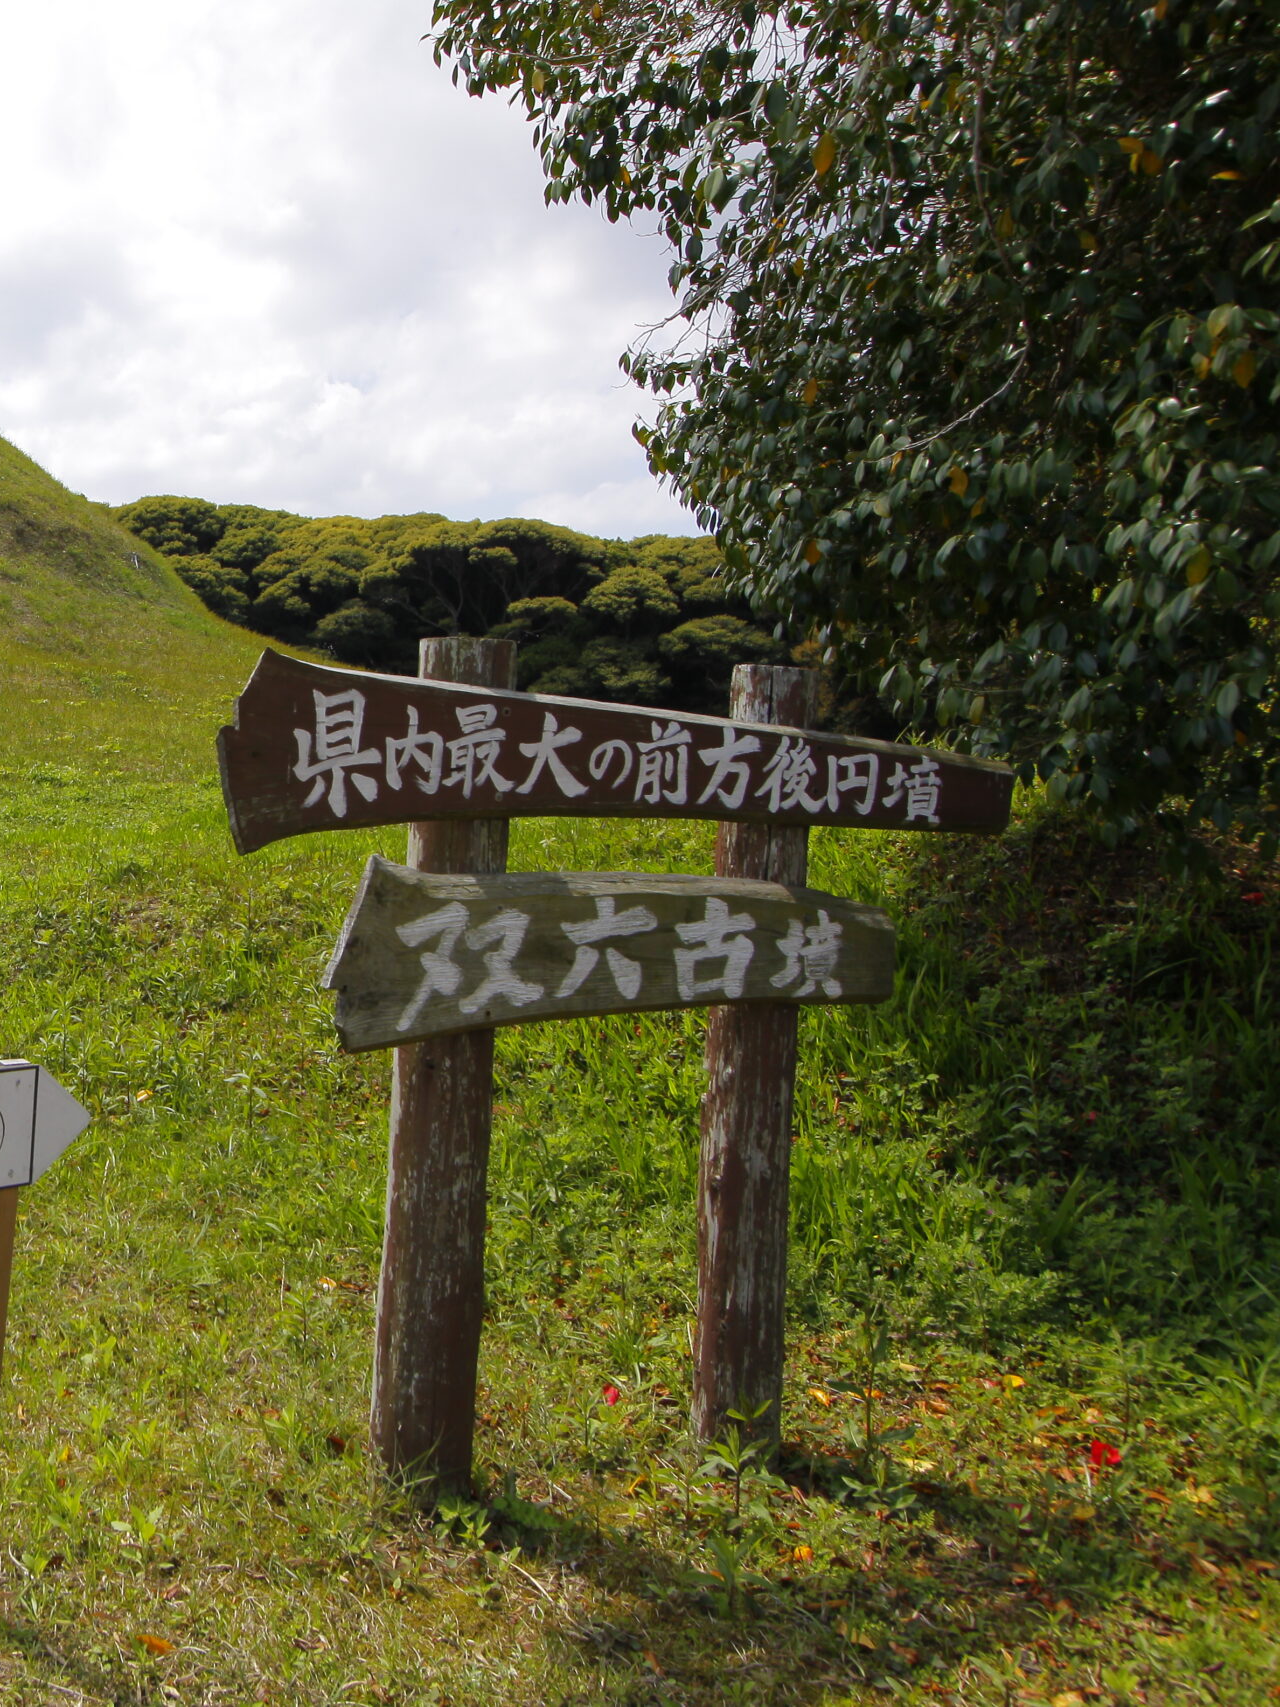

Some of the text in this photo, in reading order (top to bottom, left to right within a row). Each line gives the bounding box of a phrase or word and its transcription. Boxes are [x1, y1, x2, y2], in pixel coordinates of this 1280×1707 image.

[292, 687, 944, 828] 県内最大の前方後円墳
[395, 895, 844, 1032] 双六古墳
